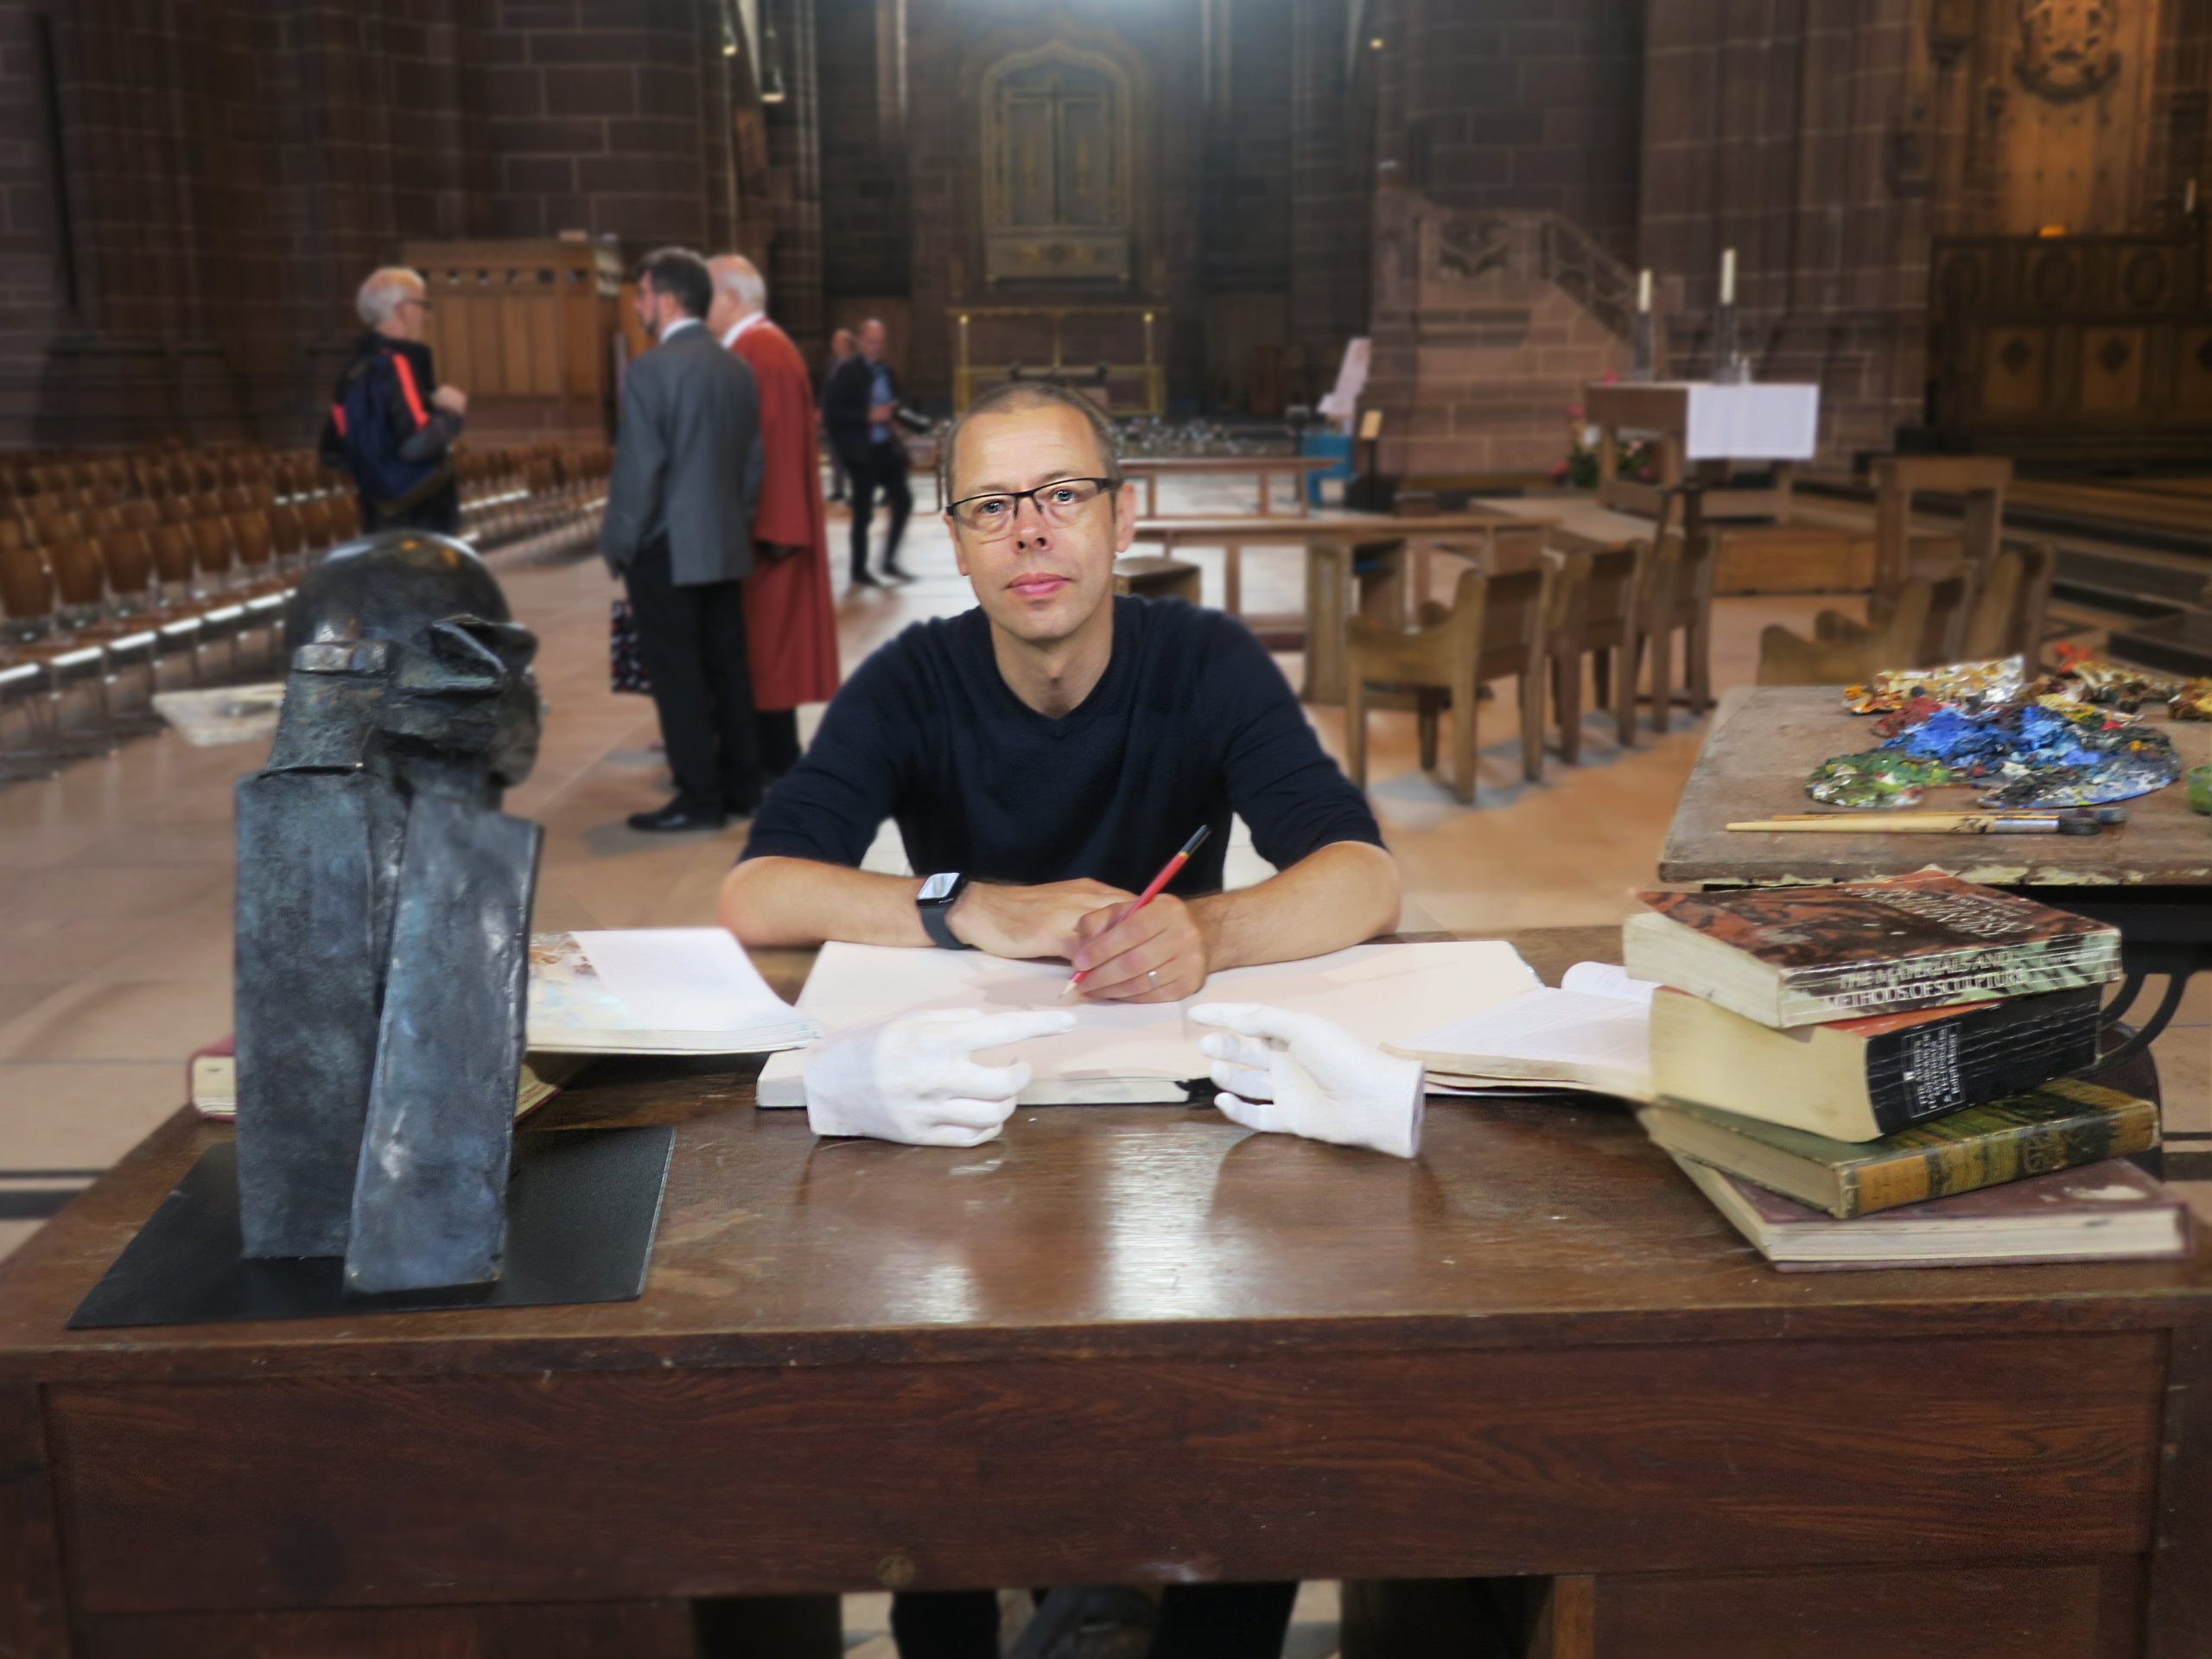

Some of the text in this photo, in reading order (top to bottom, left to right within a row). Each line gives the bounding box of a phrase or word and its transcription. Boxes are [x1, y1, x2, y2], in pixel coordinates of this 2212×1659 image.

[1825, 968, 2024, 1007] METHODS OF SCULPTURE
[1840, 950, 2013, 989] THE MATERIALS AND
